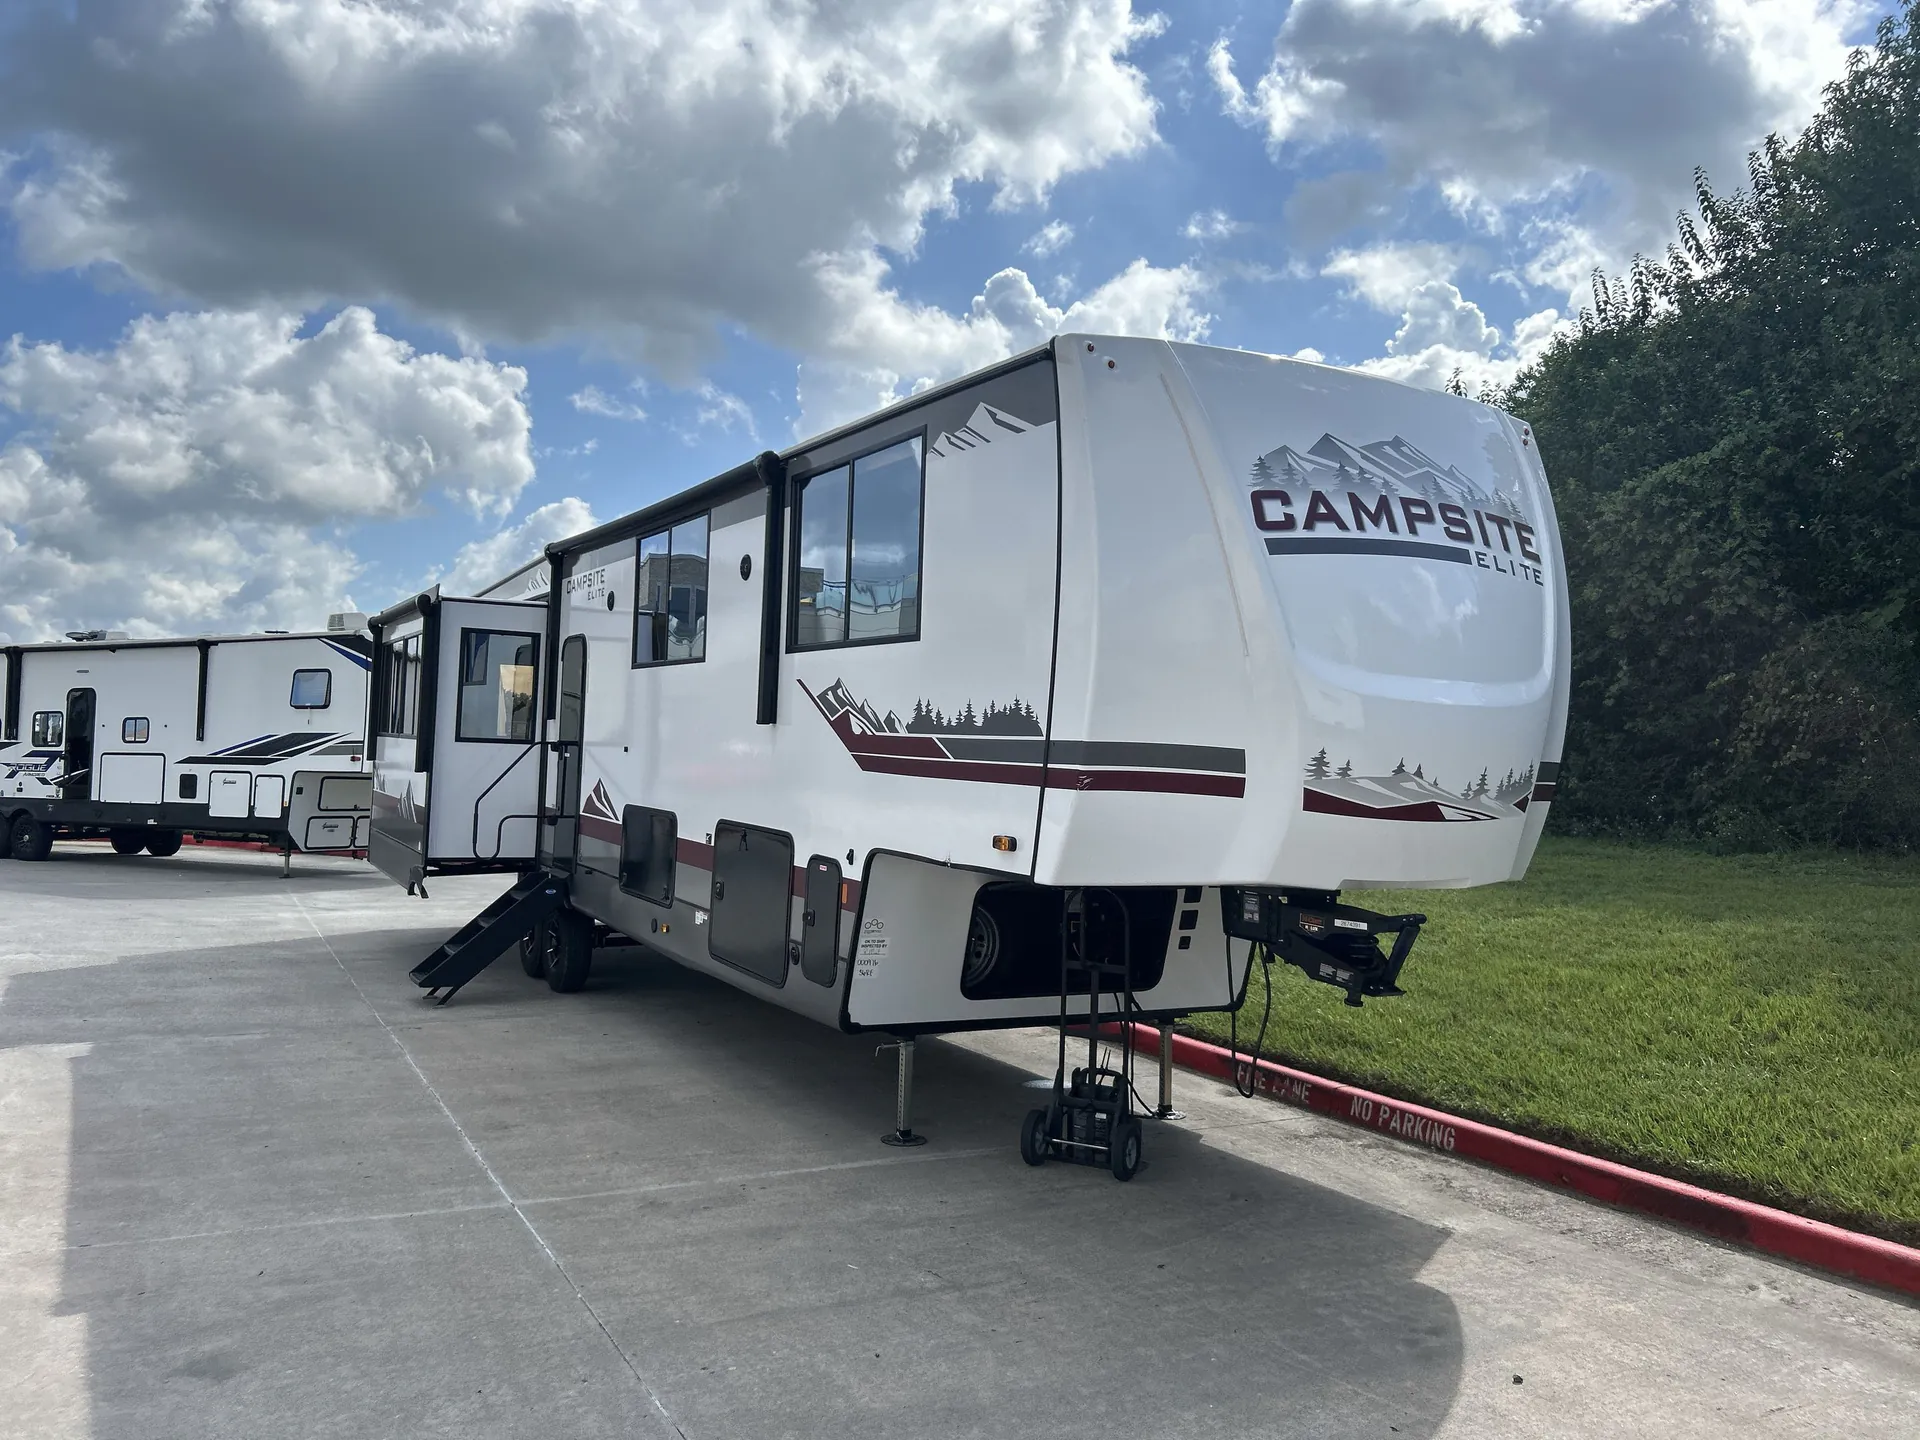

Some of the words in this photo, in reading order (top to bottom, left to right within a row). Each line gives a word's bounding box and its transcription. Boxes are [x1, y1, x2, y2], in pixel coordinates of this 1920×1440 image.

[1249, 489, 1542, 564] CAMPSITE
[566, 568, 606, 595] CAMPSITE
[1474, 550, 1544, 586] ELITE
[587, 587, 605, 601] ELITE
[1350, 1096, 1373, 1121] NO
[1378, 1104, 1456, 1151] PARKING
